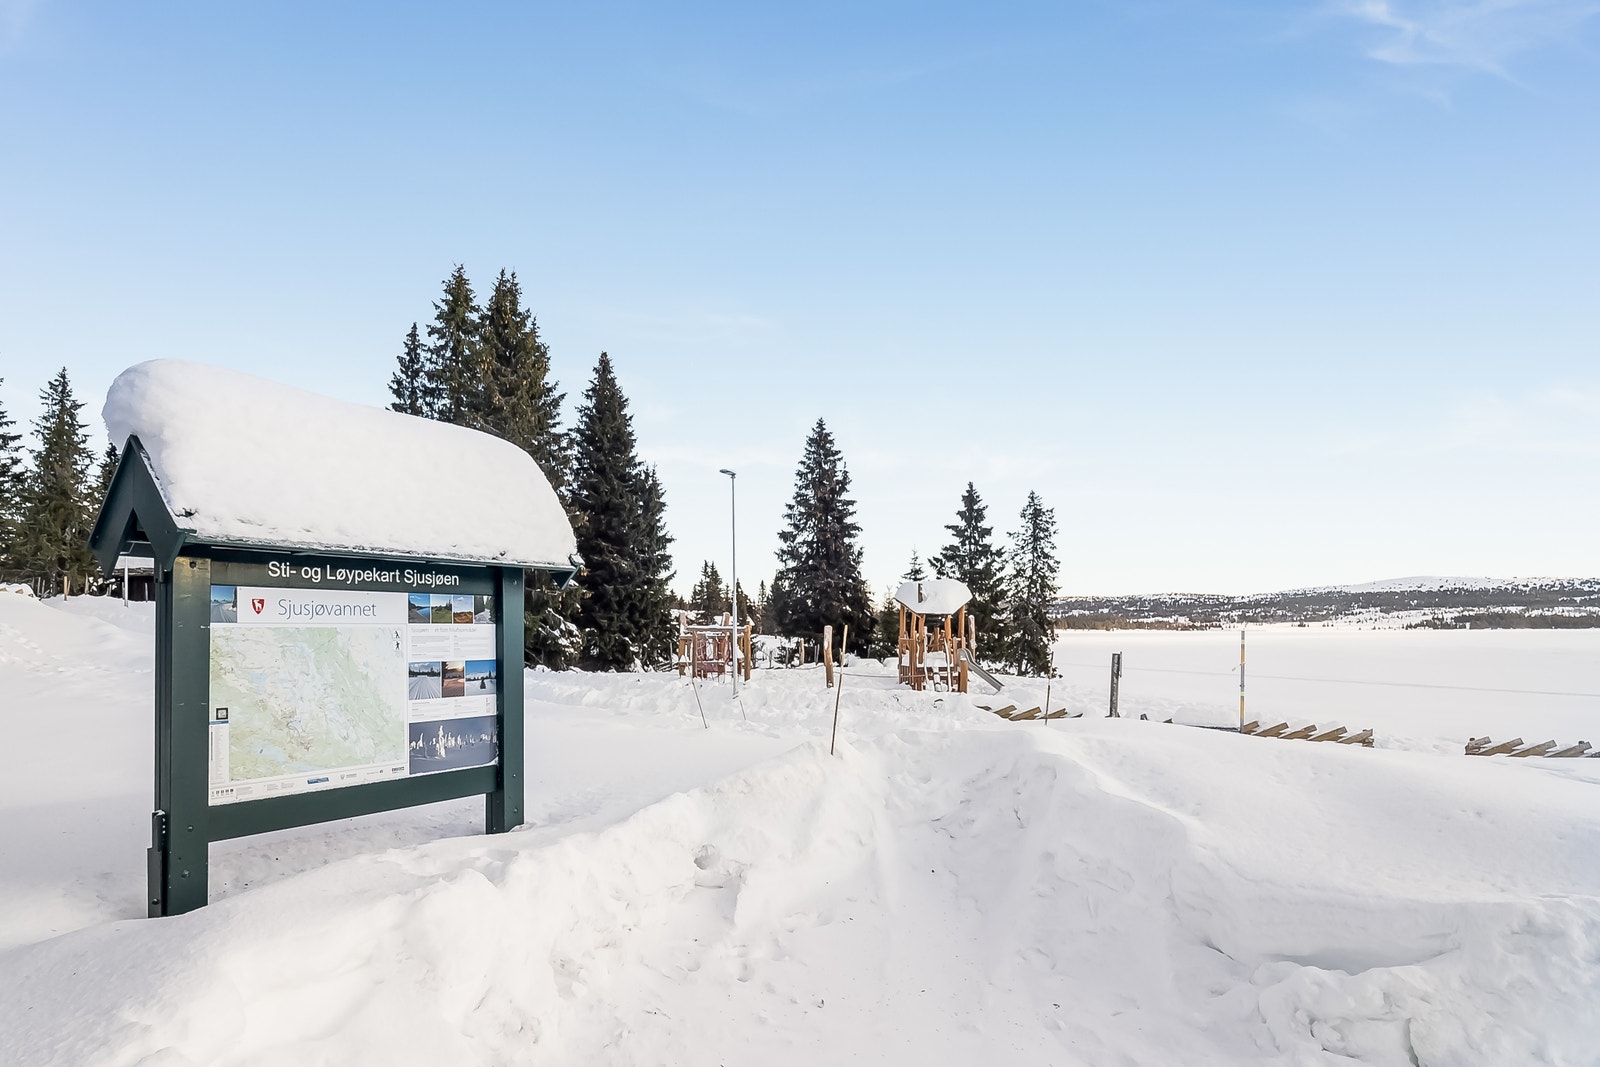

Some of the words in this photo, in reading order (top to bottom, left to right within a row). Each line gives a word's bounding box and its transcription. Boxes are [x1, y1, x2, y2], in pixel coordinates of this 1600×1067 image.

[268, 561, 296, 578] Sti-
[301, 566, 322, 583] og
[326, 565, 401, 585] Løypekart
[404, 569, 460, 588] Sjusjøen
[278, 599, 377, 620] Sjusjøvannet
